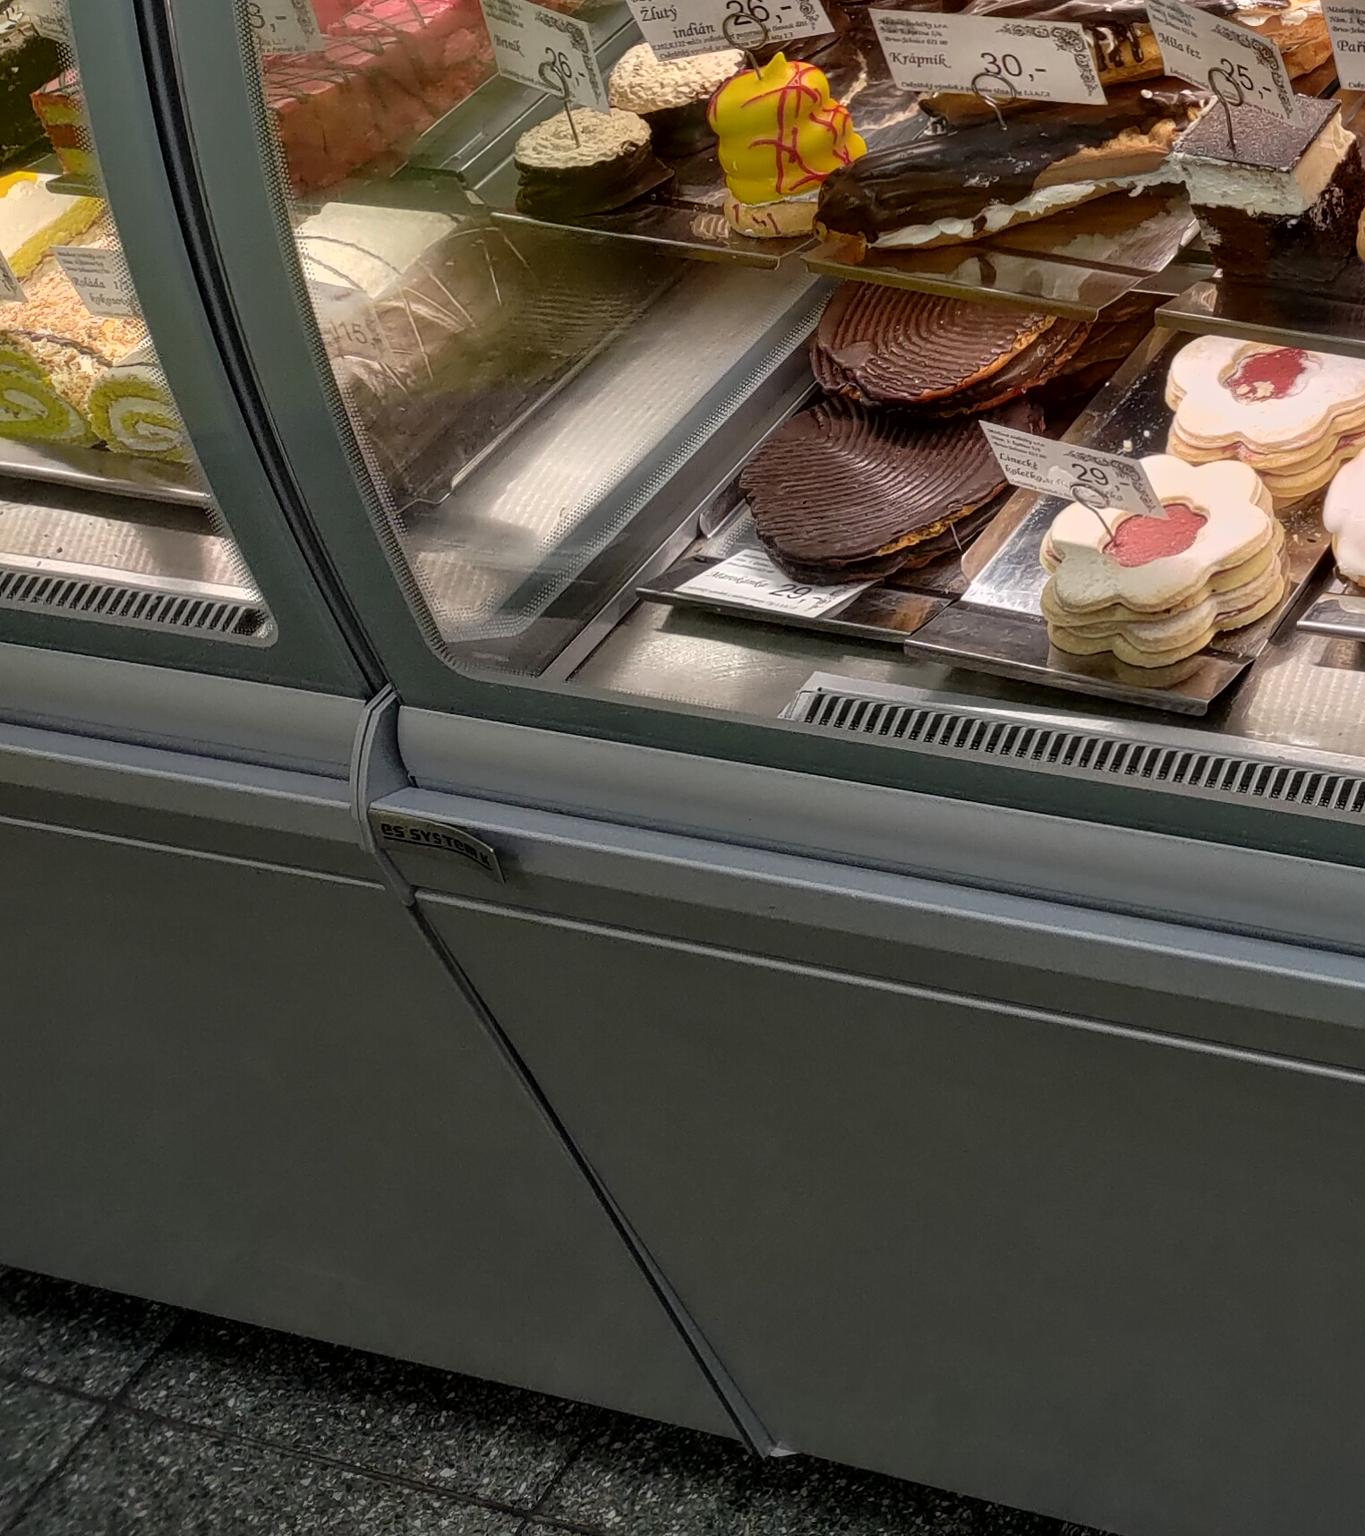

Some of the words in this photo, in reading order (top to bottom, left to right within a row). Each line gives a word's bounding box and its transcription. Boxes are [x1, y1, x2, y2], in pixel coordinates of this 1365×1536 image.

[641, 4, 677, 23] Žlutý
[673, 23, 716, 40] indián
[889, 51, 951, 69] Krápník
[981, 52, 1046, 81] 30,-
[1221, 58, 1271, 100] 25,-
[1072, 463, 1130, 492] 29,-
